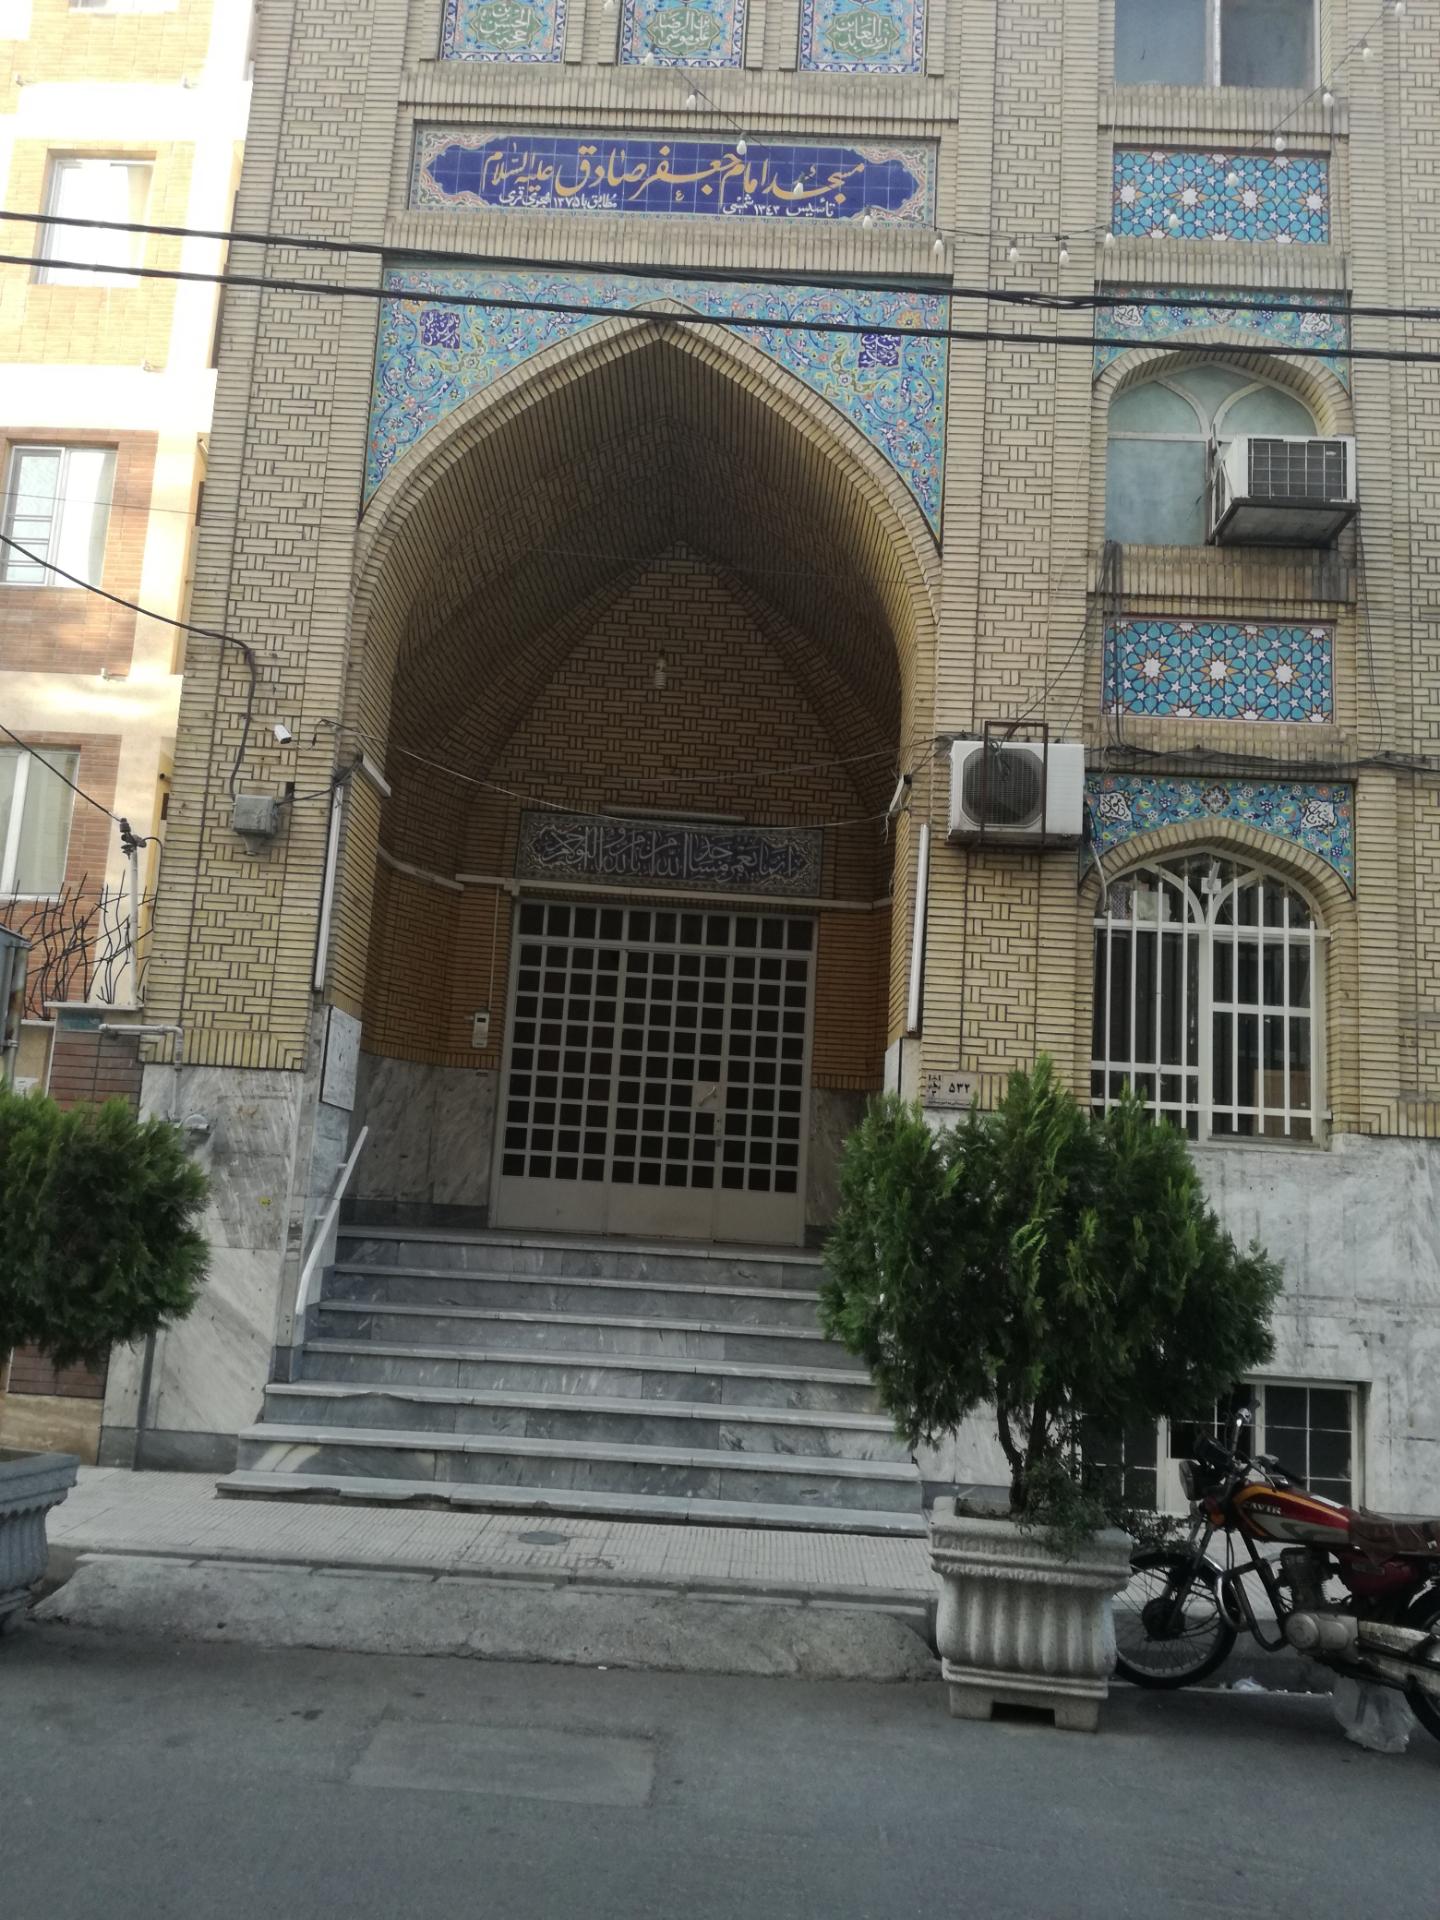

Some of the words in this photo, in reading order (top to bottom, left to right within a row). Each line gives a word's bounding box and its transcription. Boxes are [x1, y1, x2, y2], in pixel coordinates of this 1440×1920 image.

[514, 150, 554, 192] علیه
[554, 145, 648, 197] صادق
[628, 145, 744, 201] جعفر
[720, 157, 769, 208] امام
[762, 162, 865, 205] مسجد
